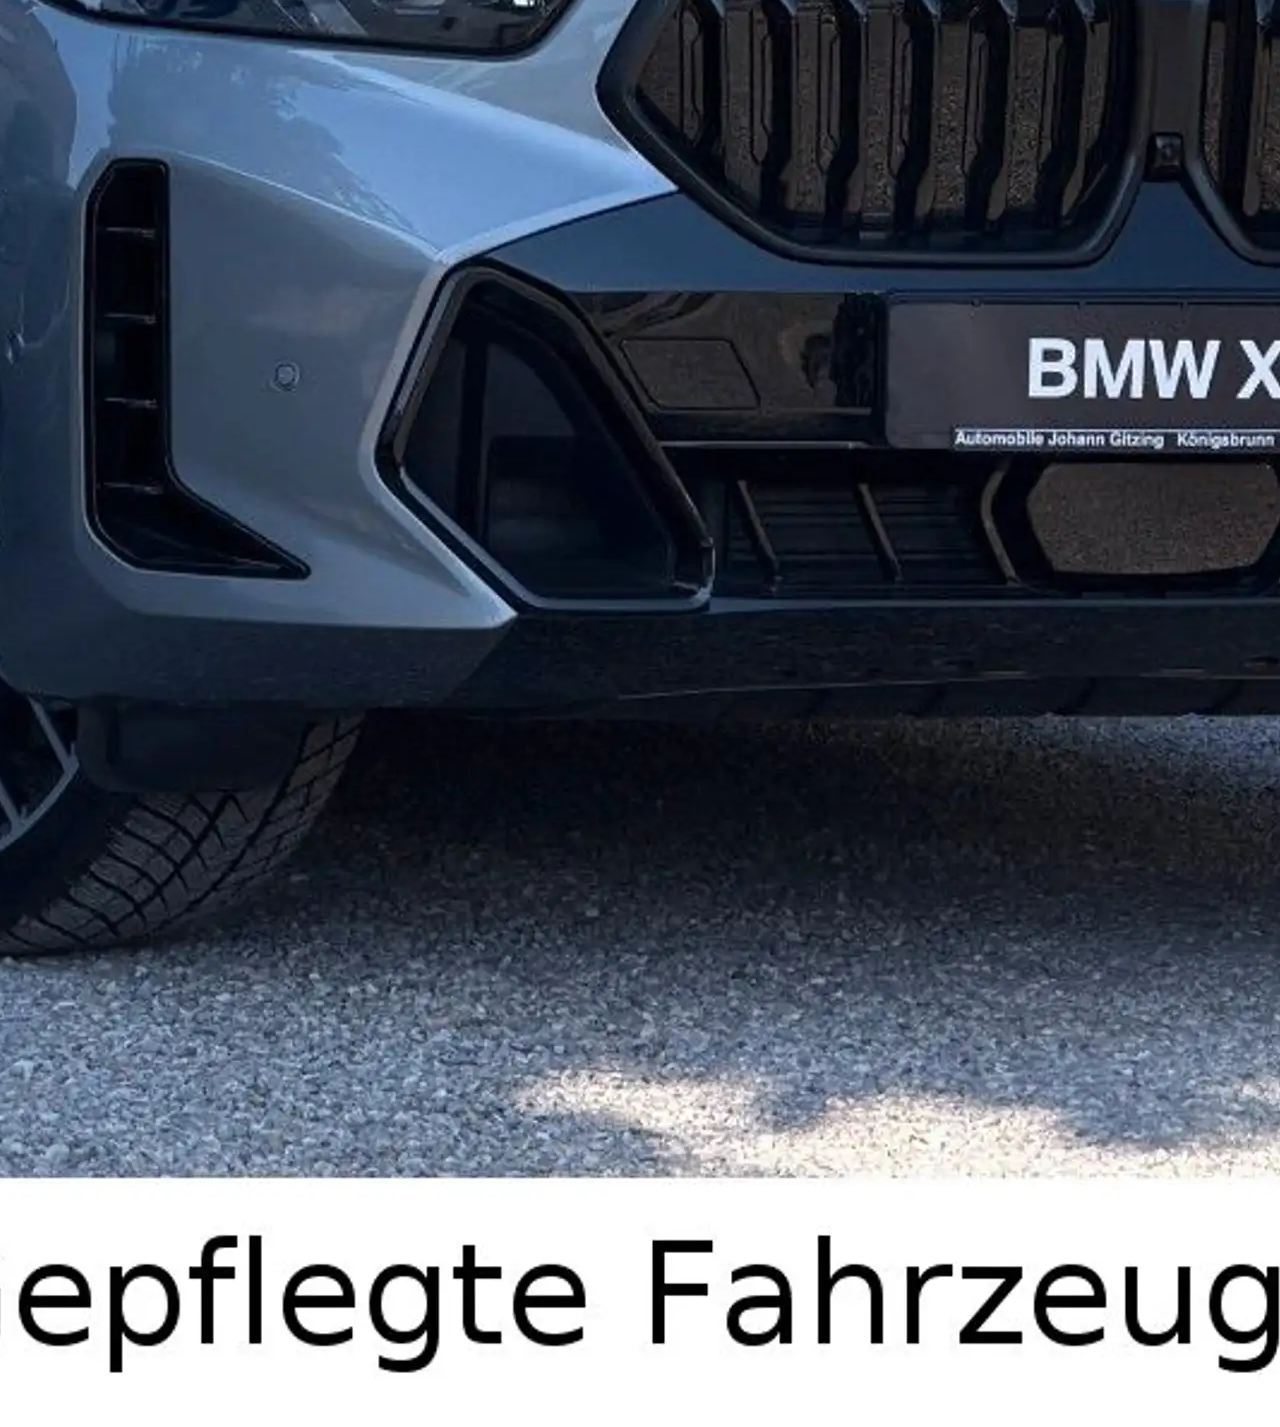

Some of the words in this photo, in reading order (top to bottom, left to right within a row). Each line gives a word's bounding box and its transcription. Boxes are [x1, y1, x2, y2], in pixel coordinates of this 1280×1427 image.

[1028, 336, 1221, 400] BMW
[954, 430, 1045, 447] Automobile
[1048, 430, 1105, 447] Johann
[1109, 430, 1165, 450] Gitzing
[1176, 429, 1275, 450] Königsbrunn
